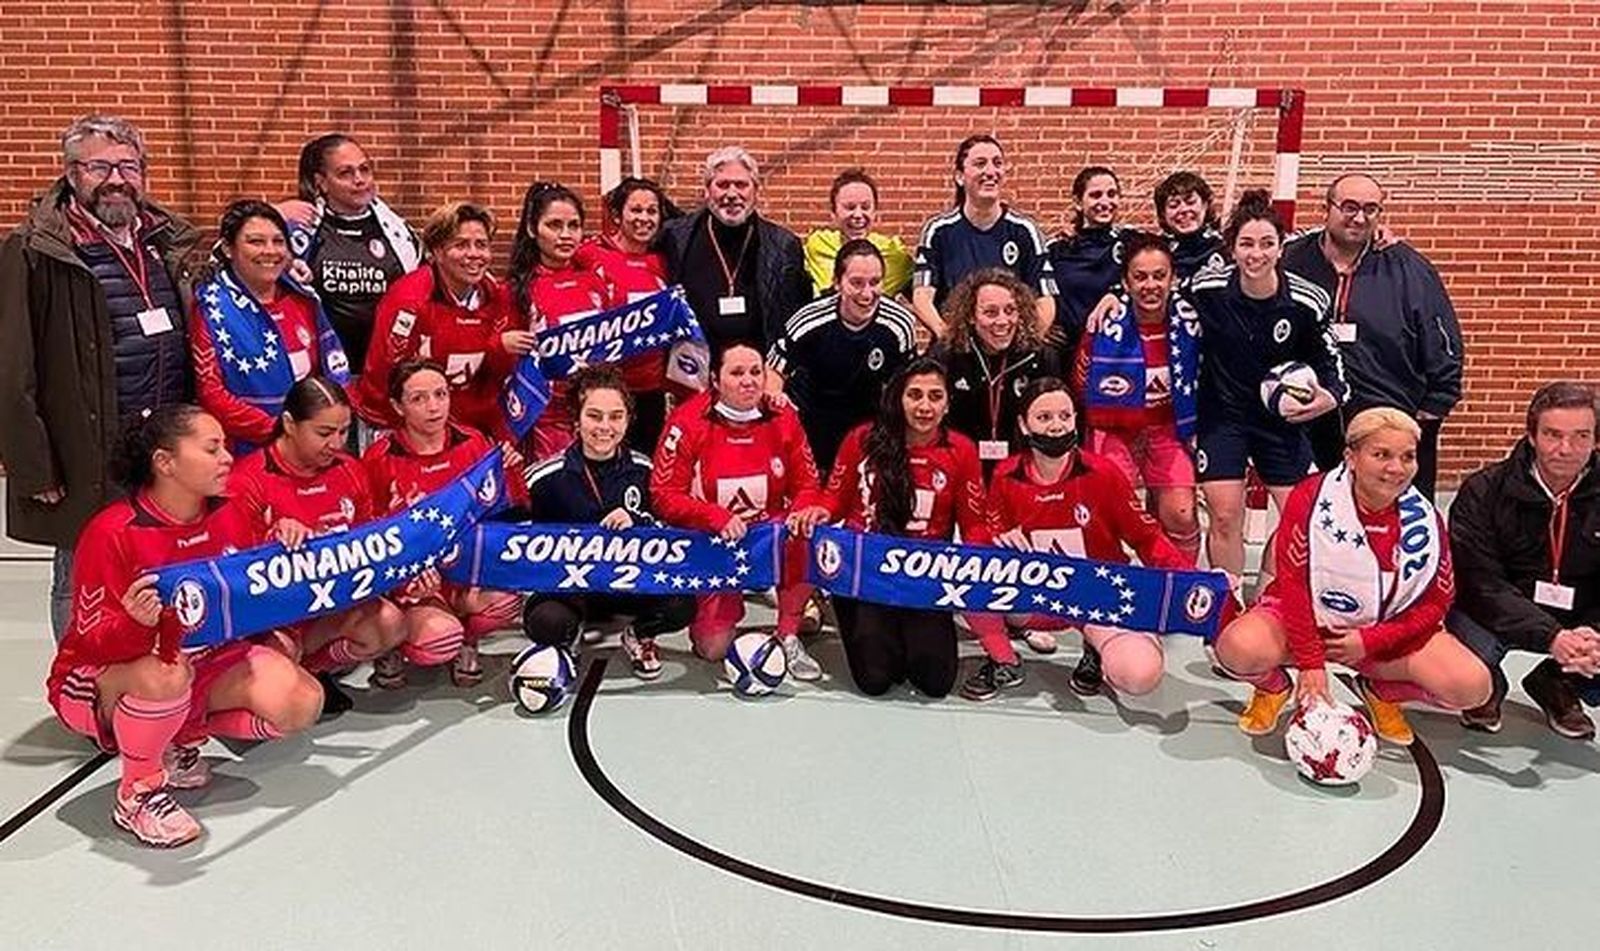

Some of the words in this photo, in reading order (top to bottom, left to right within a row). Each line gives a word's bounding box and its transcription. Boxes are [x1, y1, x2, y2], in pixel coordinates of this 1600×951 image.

[322, 265, 384, 280] Khalifa
[322, 279, 387, 295] Capital
[530, 302, 658, 368] OÑAMOS
[566, 349, 593, 375] X
[605, 338, 625, 363] 2
[500, 529, 692, 564] SOÑAMOS
[557, 564, 596, 589] X
[608, 565, 642, 589] 2
[879, 547, 1076, 590] SOÑAMOS
[307, 579, 337, 613] X
[351, 567, 375, 600] 2
[935, 582, 973, 609] X
[986, 586, 1020, 611] 2
